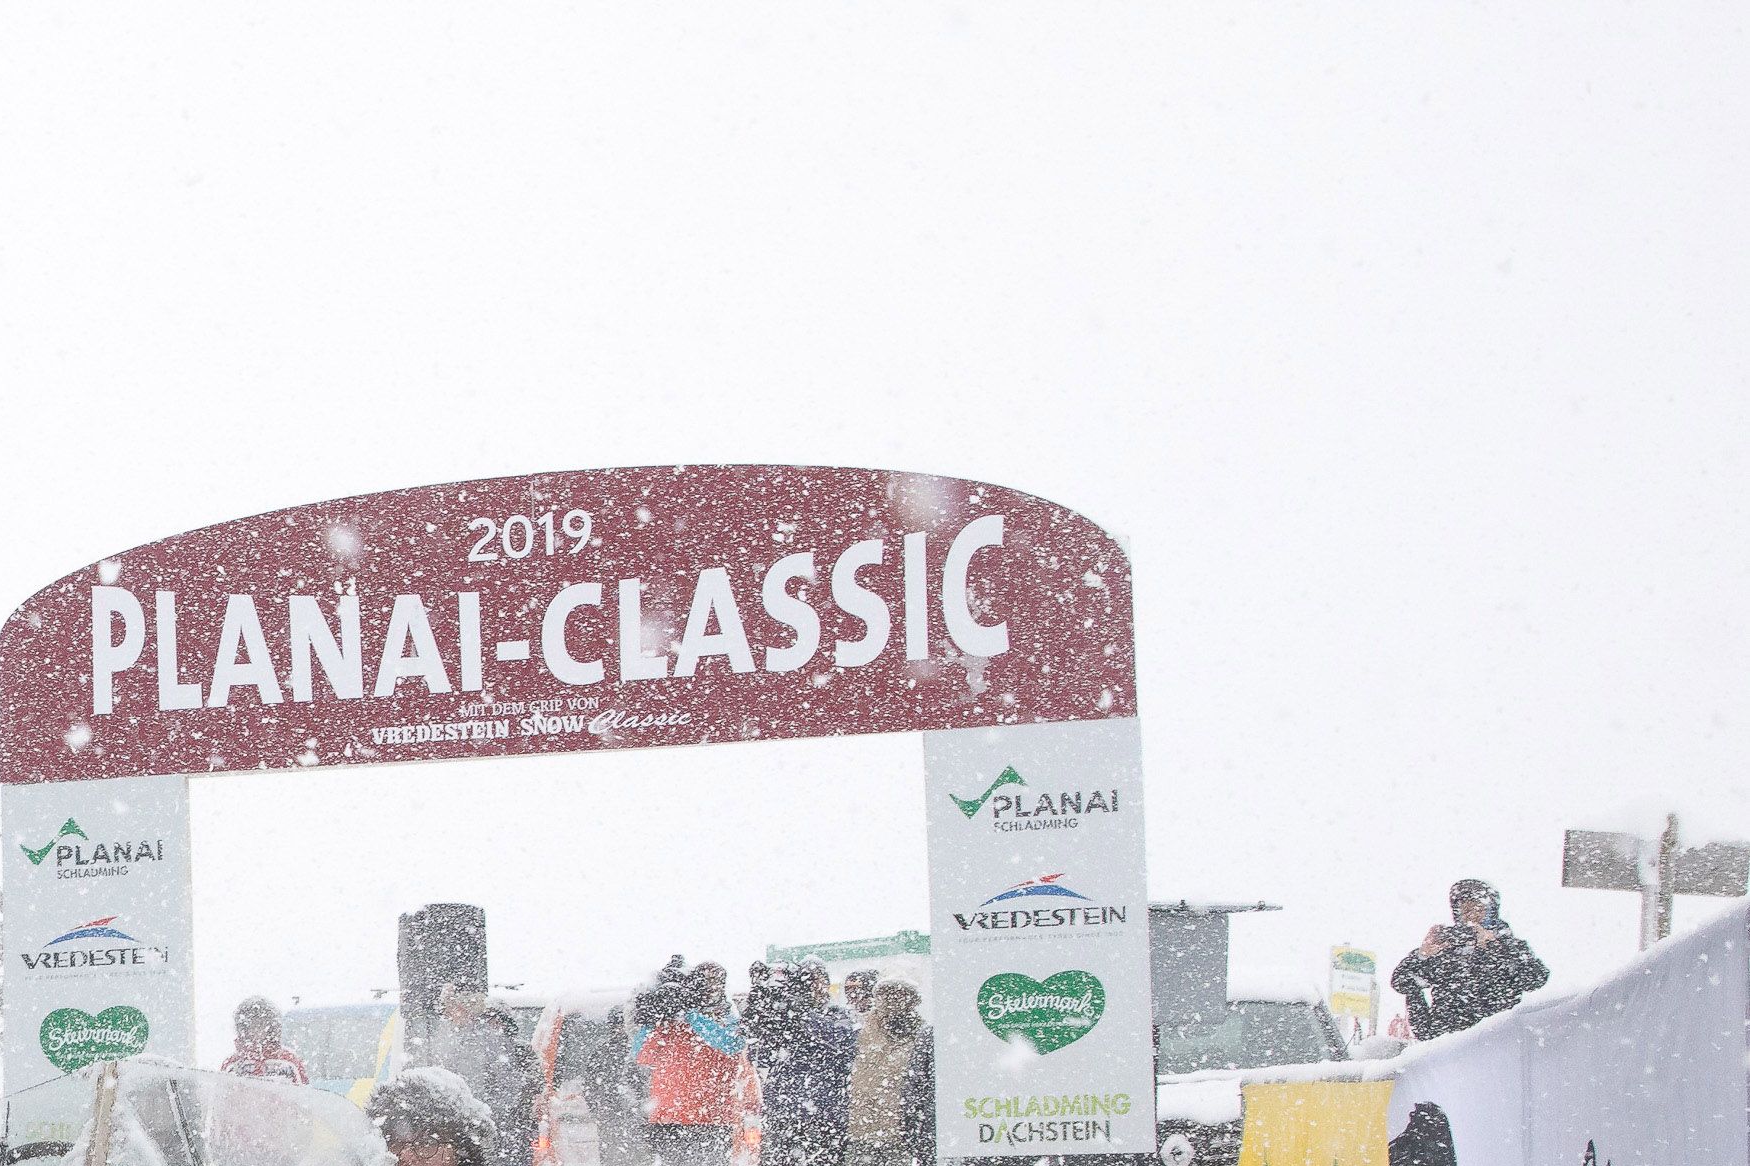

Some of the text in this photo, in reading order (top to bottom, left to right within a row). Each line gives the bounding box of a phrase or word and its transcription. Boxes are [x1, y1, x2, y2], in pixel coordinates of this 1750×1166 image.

[468, 509, 592, 562] 2019
[90, 513, 1011, 716] PLANAI-CLASSIC
[459, 697, 599, 718] MIT DEM GRIP VON
[371, 709, 692, 745] VREDESTEIN SNOW Classic
[993, 789, 1119, 819] PLANAI
[993, 818, 1079, 833] SCHLADMING
[56, 839, 163, 867] PLANAI
[57, 865, 129, 880] SCHLADMING
[952, 905, 1127, 931] VREDESTEIN
[20, 946, 169, 970] VREDESTEN
[988, 989, 1095, 1020] Steiermark
[963, 1092, 1132, 1119] SCHLADMING
[978, 1118, 1111, 1149] DACHSTEIN
